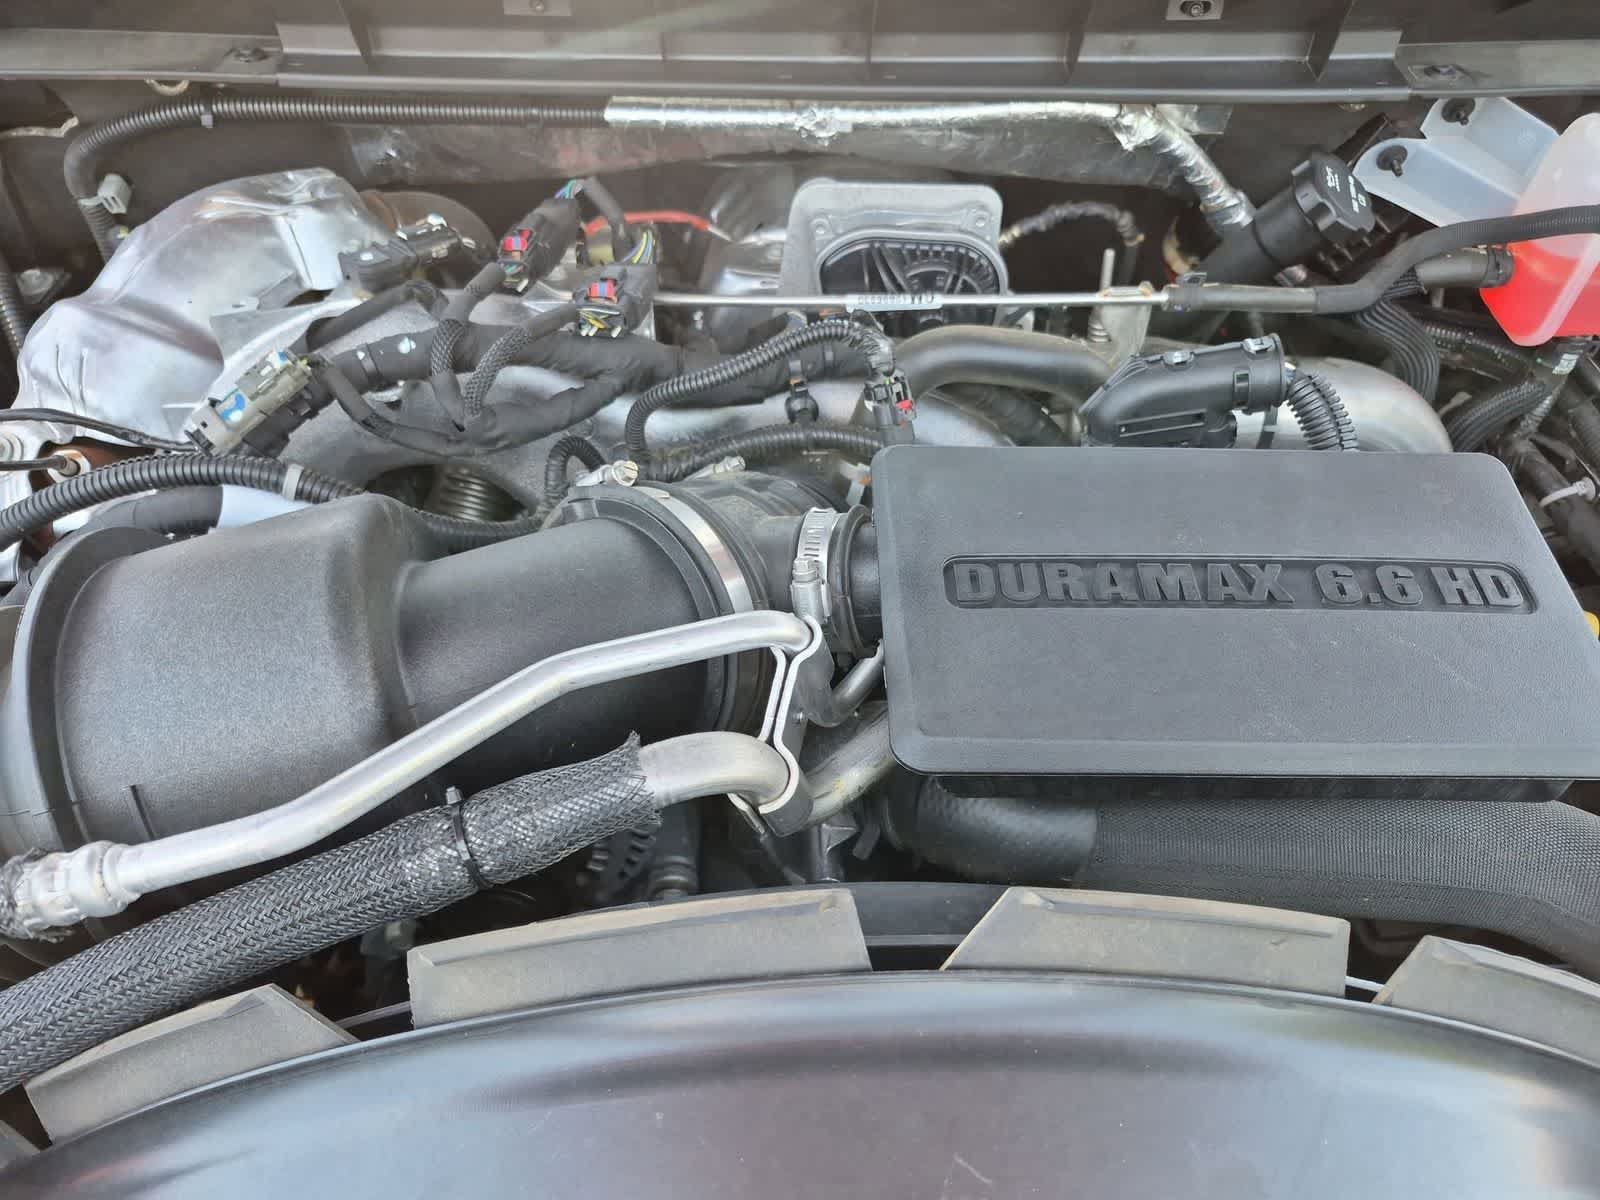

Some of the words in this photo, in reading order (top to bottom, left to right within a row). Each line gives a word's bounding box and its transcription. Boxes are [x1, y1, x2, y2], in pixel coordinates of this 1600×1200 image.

[954, 562, 1295, 604] DURAMAX
[1315, 564, 1424, 605] 6.6
[1430, 566, 1524, 607] HD
